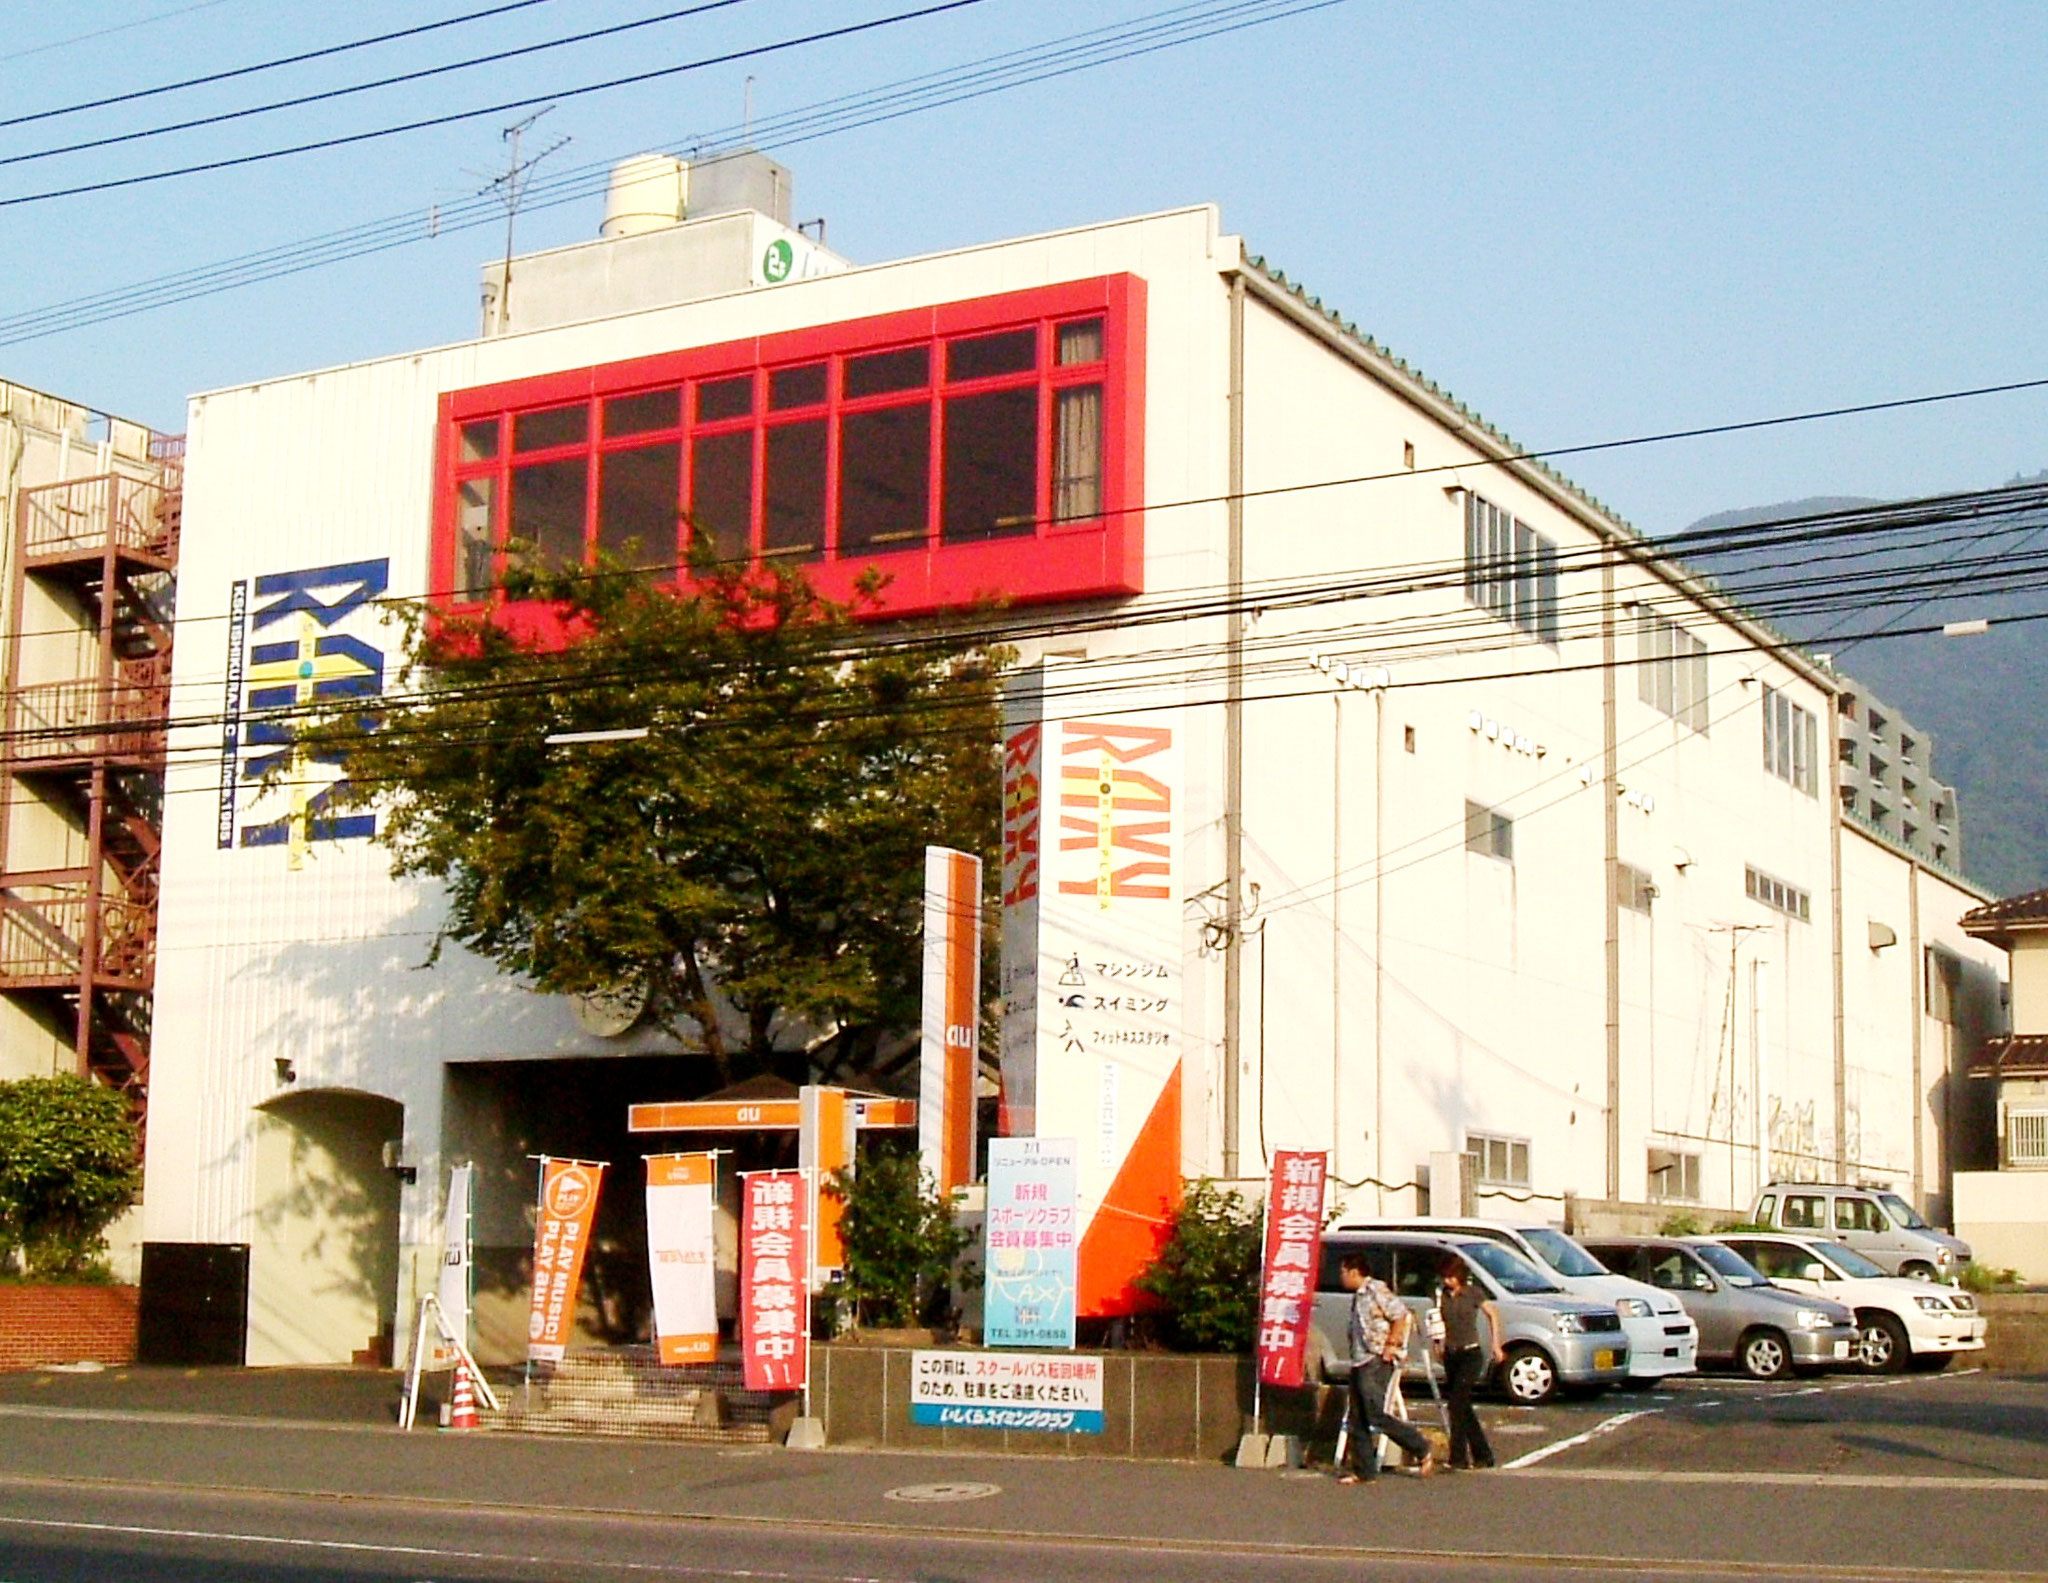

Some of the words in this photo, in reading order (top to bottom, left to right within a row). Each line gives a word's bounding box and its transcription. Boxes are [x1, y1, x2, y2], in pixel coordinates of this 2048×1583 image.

[1005, 722, 1039, 907] RAXY
[1059, 721, 1171, 899] RAXY
[1094, 963, 1169, 978] マシンジム
[1093, 996, 1169, 1012] スイミング
[946, 1025, 971, 1048] au
[737, 1106, 760, 1122] au
[1014, 1183, 1048, 1201] 新規
[991, 1207, 1071, 1224] スポーツクラブ
[539, 1220, 560, 1270] PLAY
[557, 1221, 579, 1270] PLAY
[990, 1231, 1072, 1248] 会員募集中
[1260, 1158, 1322, 1378] 新規会員募集中!!
[544, 1271, 568, 1341] MUSIC!
